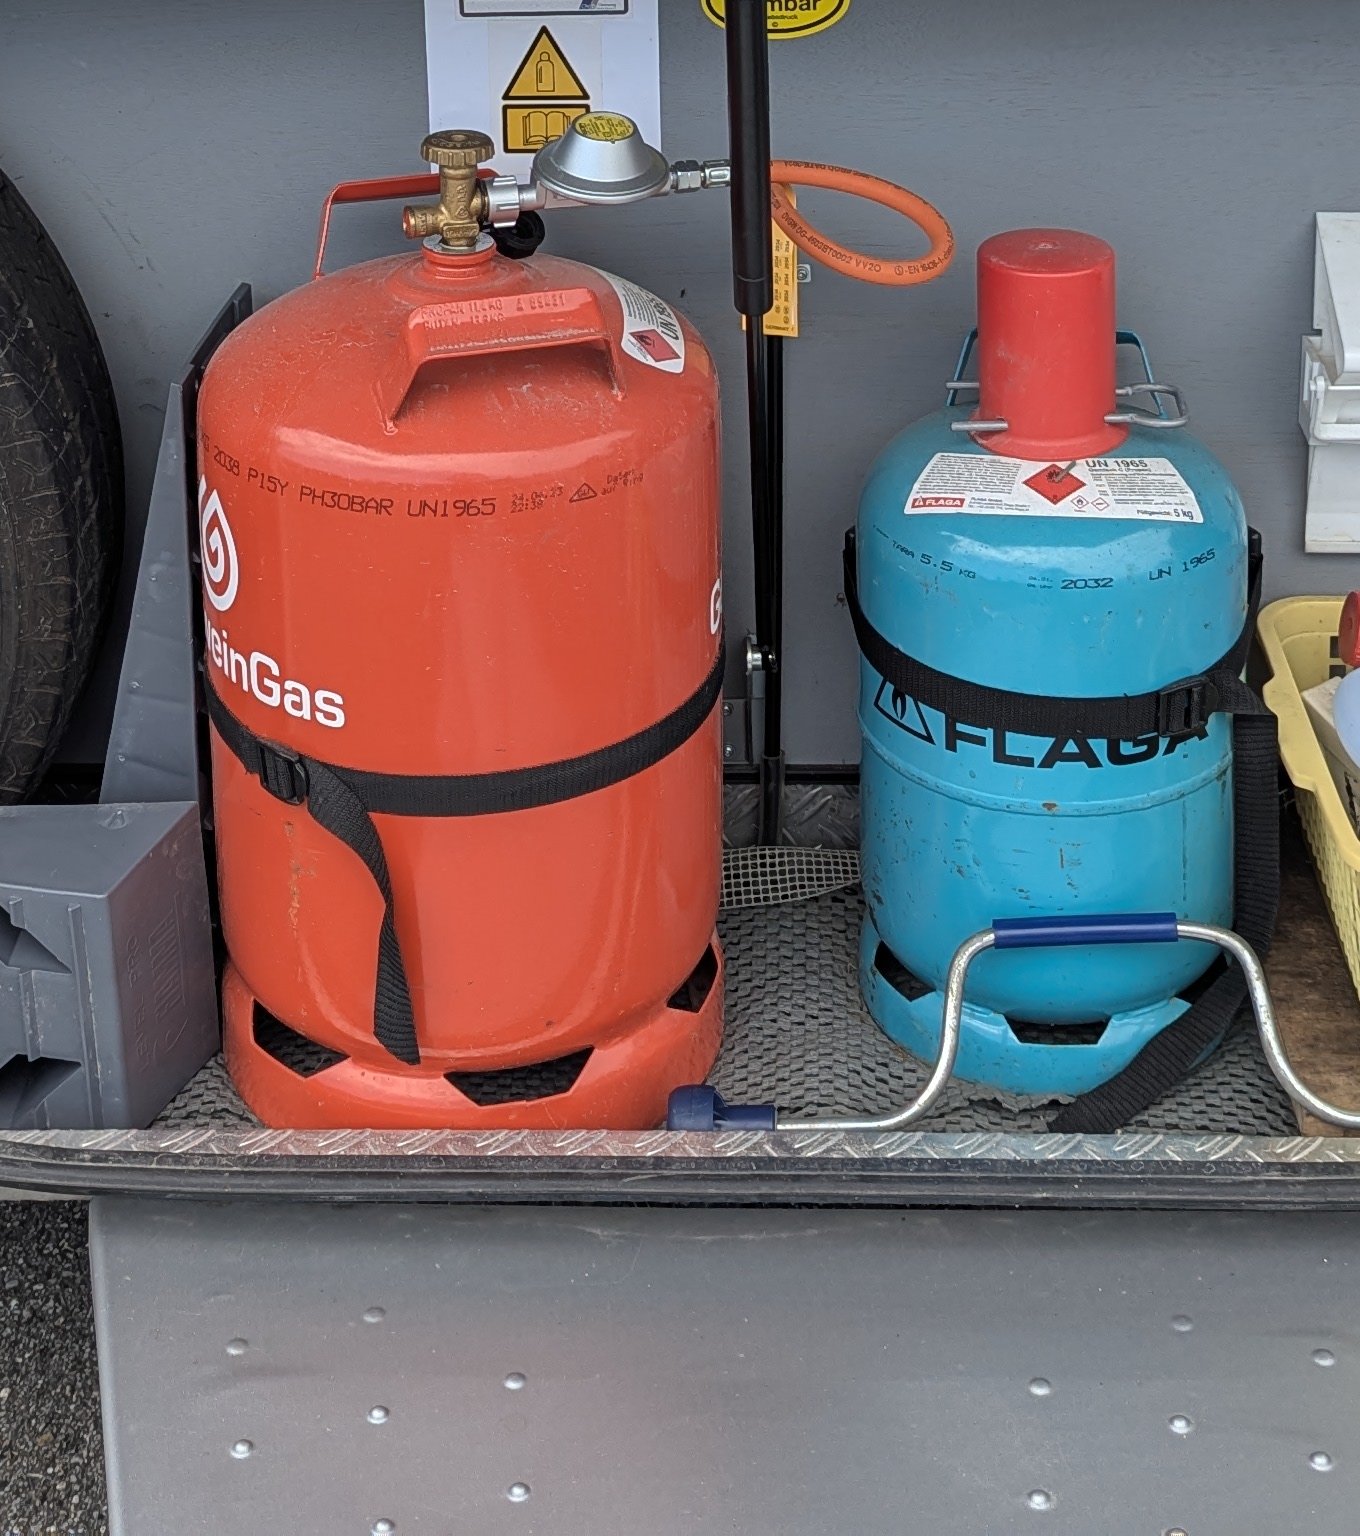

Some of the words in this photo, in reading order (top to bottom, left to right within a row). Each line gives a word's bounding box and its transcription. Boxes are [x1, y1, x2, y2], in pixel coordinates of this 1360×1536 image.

[1085, 460, 1109, 468] UN
[1114, 460, 1148, 468] 1965
[214, 445, 240, 476] 2038
[407, 498, 497, 517] UN1965
[925, 498, 962, 507] FLAGA
[1173, 509, 1180, 517] 5
[1181, 509, 1194, 520] kg
[920, 553, 954, 572] 5.5
[959, 568, 976, 579] KG
[1149, 566, 1172, 581] UN
[1182, 548, 1216, 572] 1965
[1060, 577, 1114, 590] 2032
